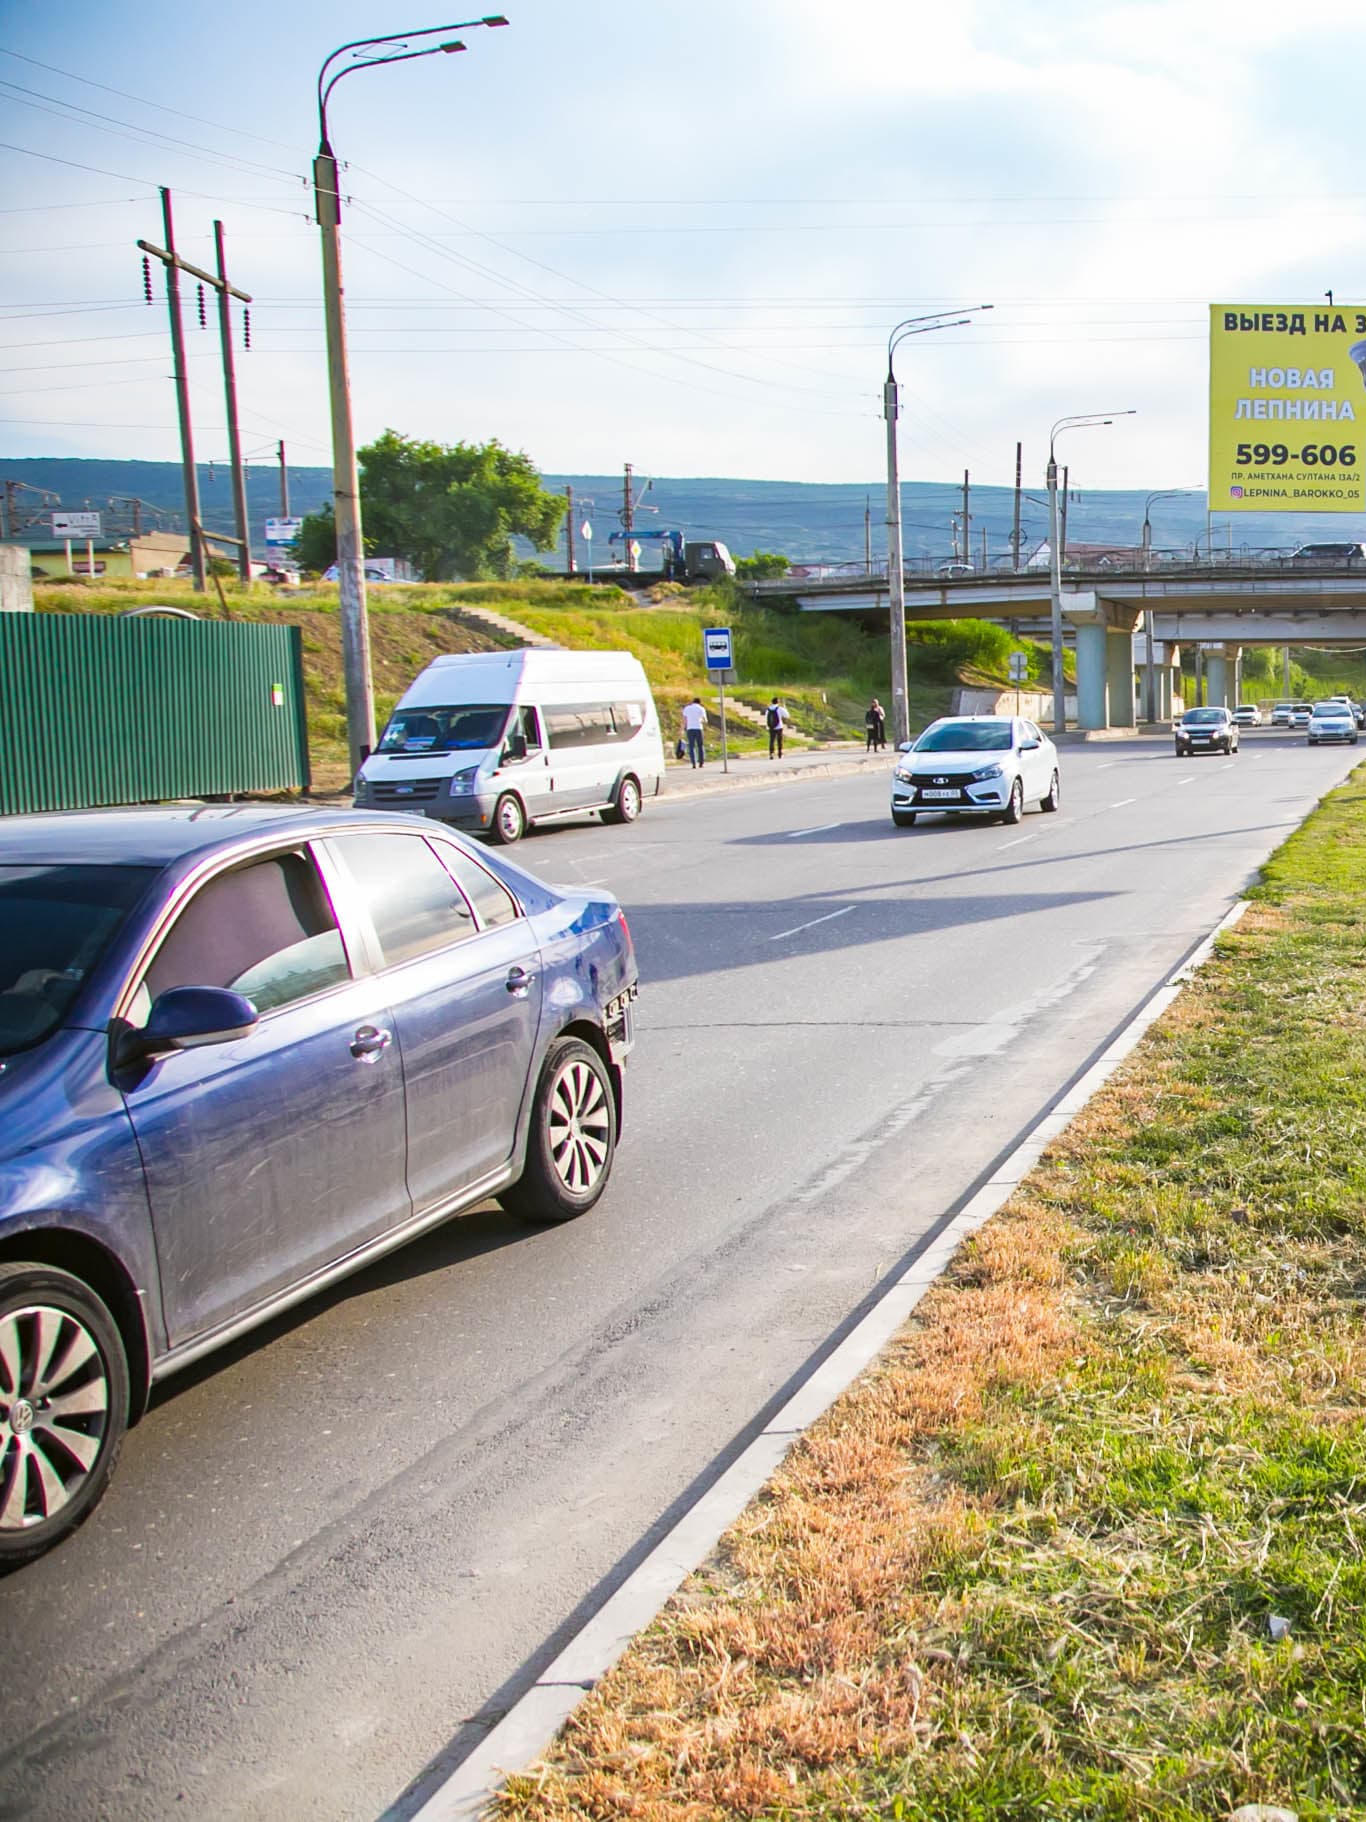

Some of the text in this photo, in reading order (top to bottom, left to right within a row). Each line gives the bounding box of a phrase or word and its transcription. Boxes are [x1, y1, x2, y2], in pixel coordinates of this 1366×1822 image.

[1224, 312, 1306, 335] ВЫЕЗД
[1314, 314, 1347, 333] НА
[1249, 367, 1334, 389] НОВАЯ
[1235, 398, 1355, 421] ЛЕПНИНА
[1235, 443, 1356, 466] 599-606
[1231, 472, 1245, 480] ПР.
[1247, 472, 1293, 481] АМЕТХАНА
[1296, 473, 1336, 481] СУЛТАНА
[1243, 488, 1360, 499] LEPNINA_BAROKKO_05
